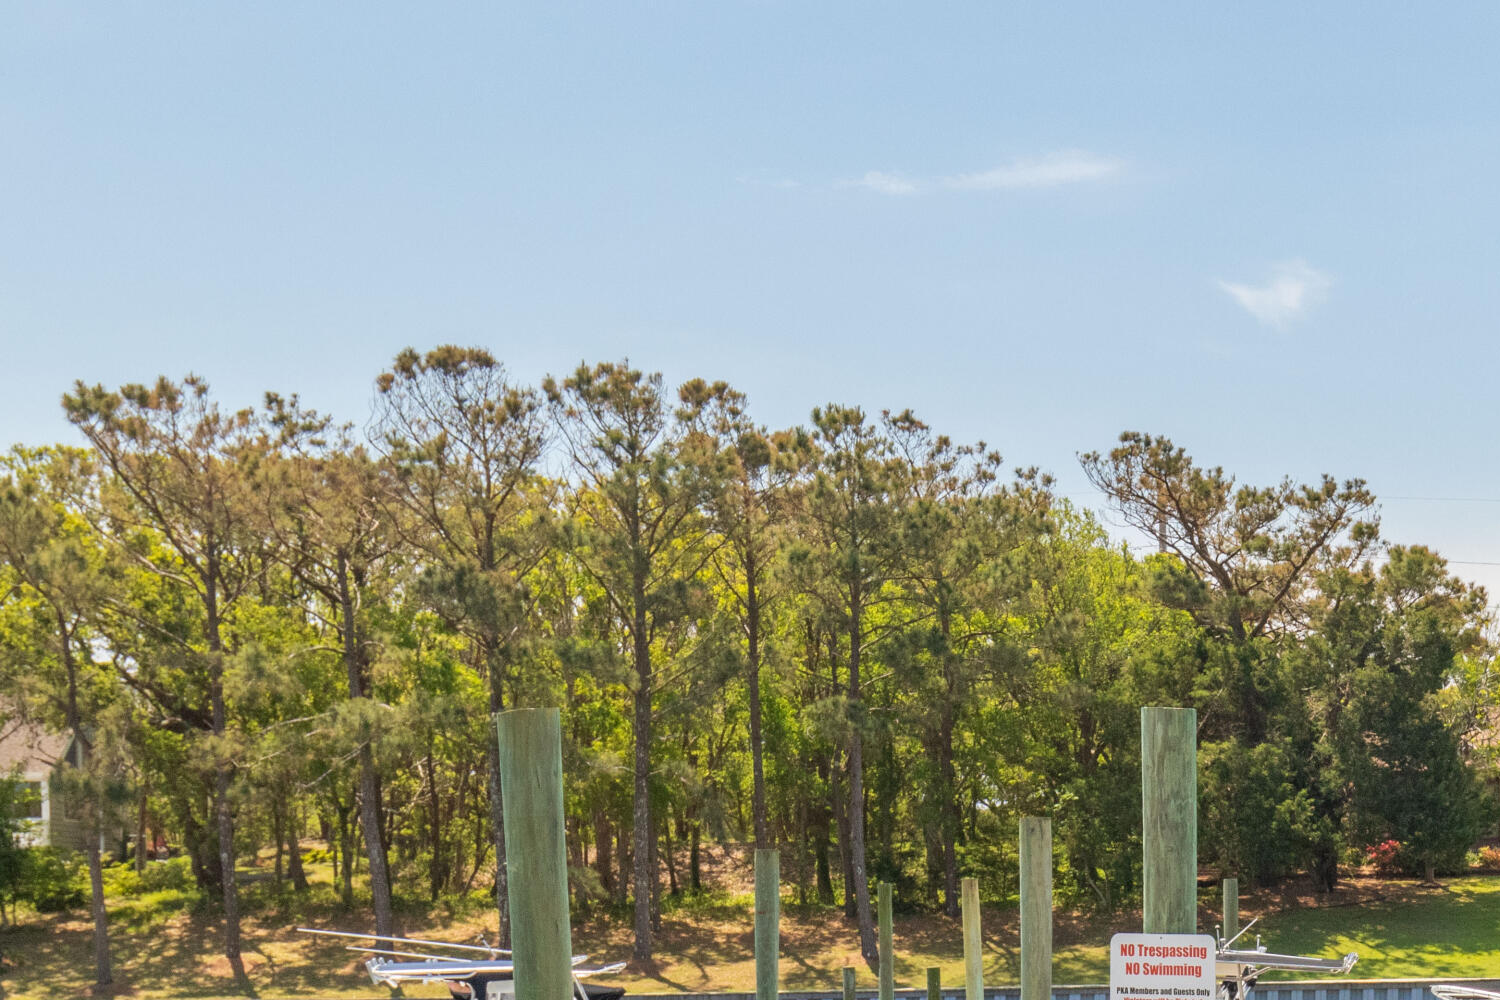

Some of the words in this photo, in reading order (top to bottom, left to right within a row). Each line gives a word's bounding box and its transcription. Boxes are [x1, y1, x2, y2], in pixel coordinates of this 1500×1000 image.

[1120, 944, 1135, 957] NO
[1137, 944, 1207, 960] Trespassing
[1125, 962, 1140, 975] NO
[1143, 962, 1202, 978] Swimming
[1116, 987, 1129, 995] PKA
[1130, 987, 1160, 995] Members
[1173, 988, 1195, 996] Guests
[1196, 988, 1210, 997] Only
